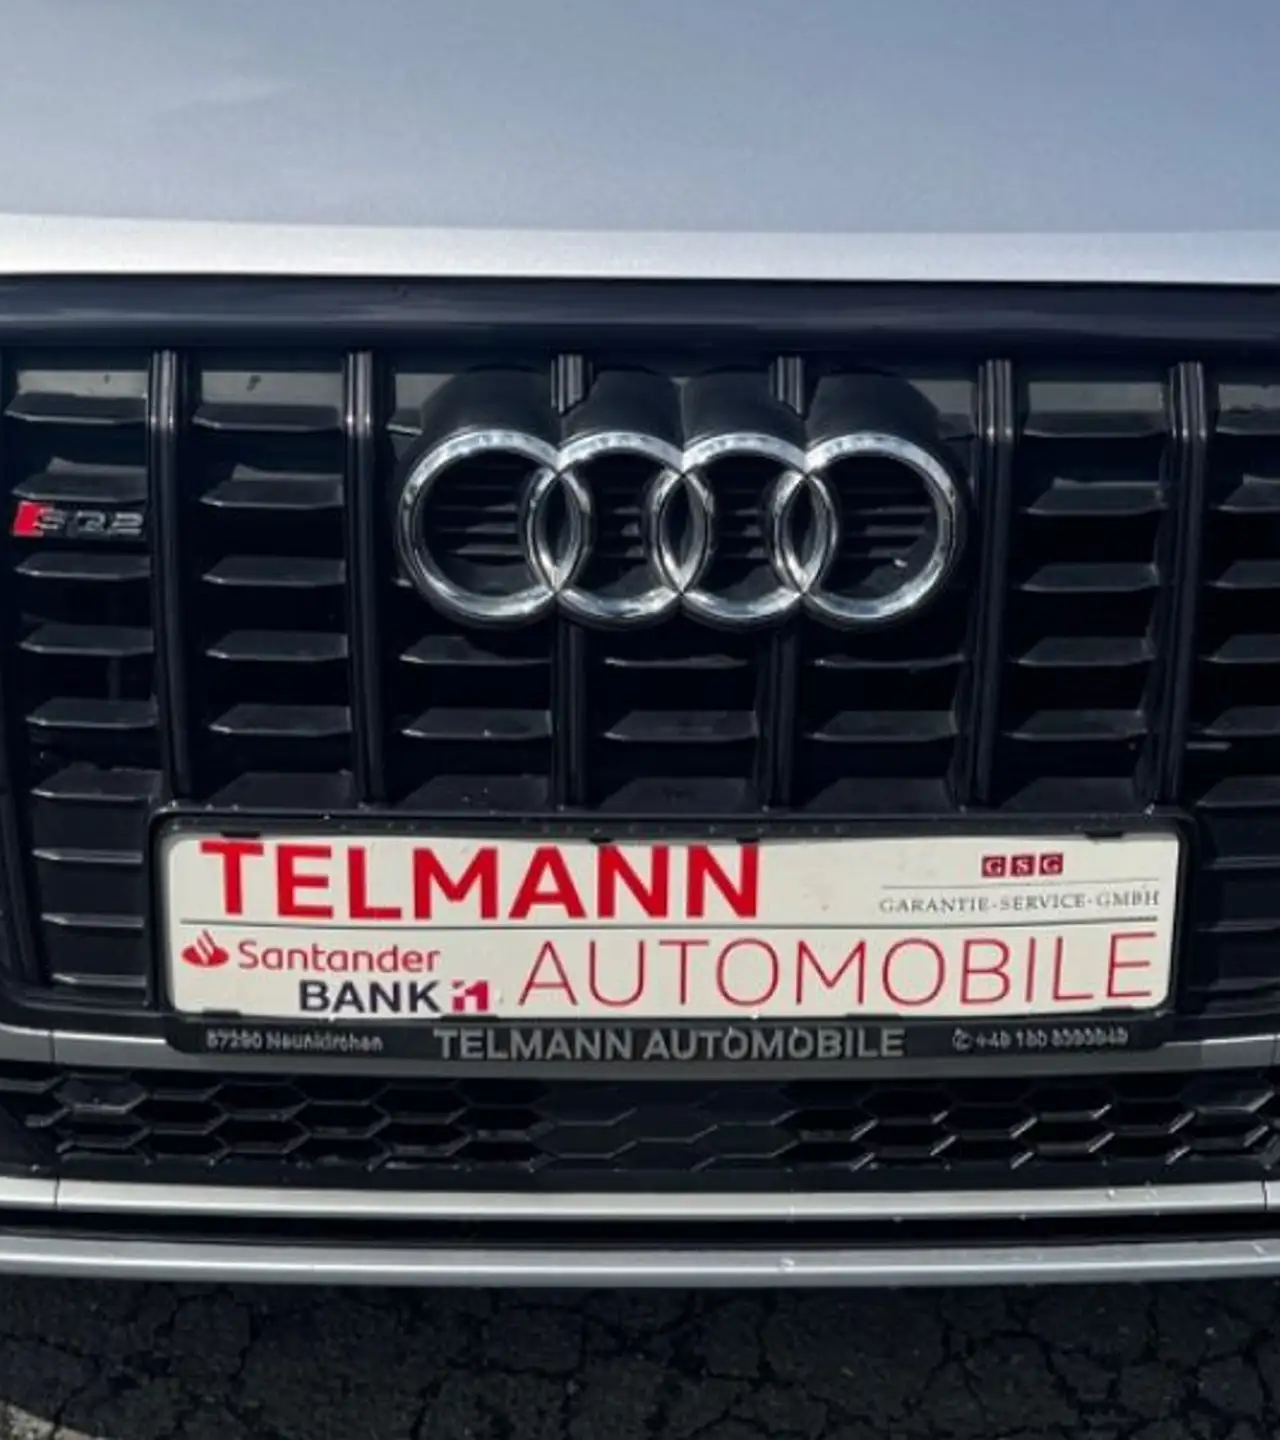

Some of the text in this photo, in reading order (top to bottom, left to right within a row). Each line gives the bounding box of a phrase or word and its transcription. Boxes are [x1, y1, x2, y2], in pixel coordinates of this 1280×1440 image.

[200, 840, 759, 920] TELMANN
[981, 853, 1064, 878] GSG
[237, 940, 440, 973] Santander
[518, 932, 1157, 1006] AUTOMOBILE
[433, 1027, 906, 1060] TELMANN AUTOMOBILE
